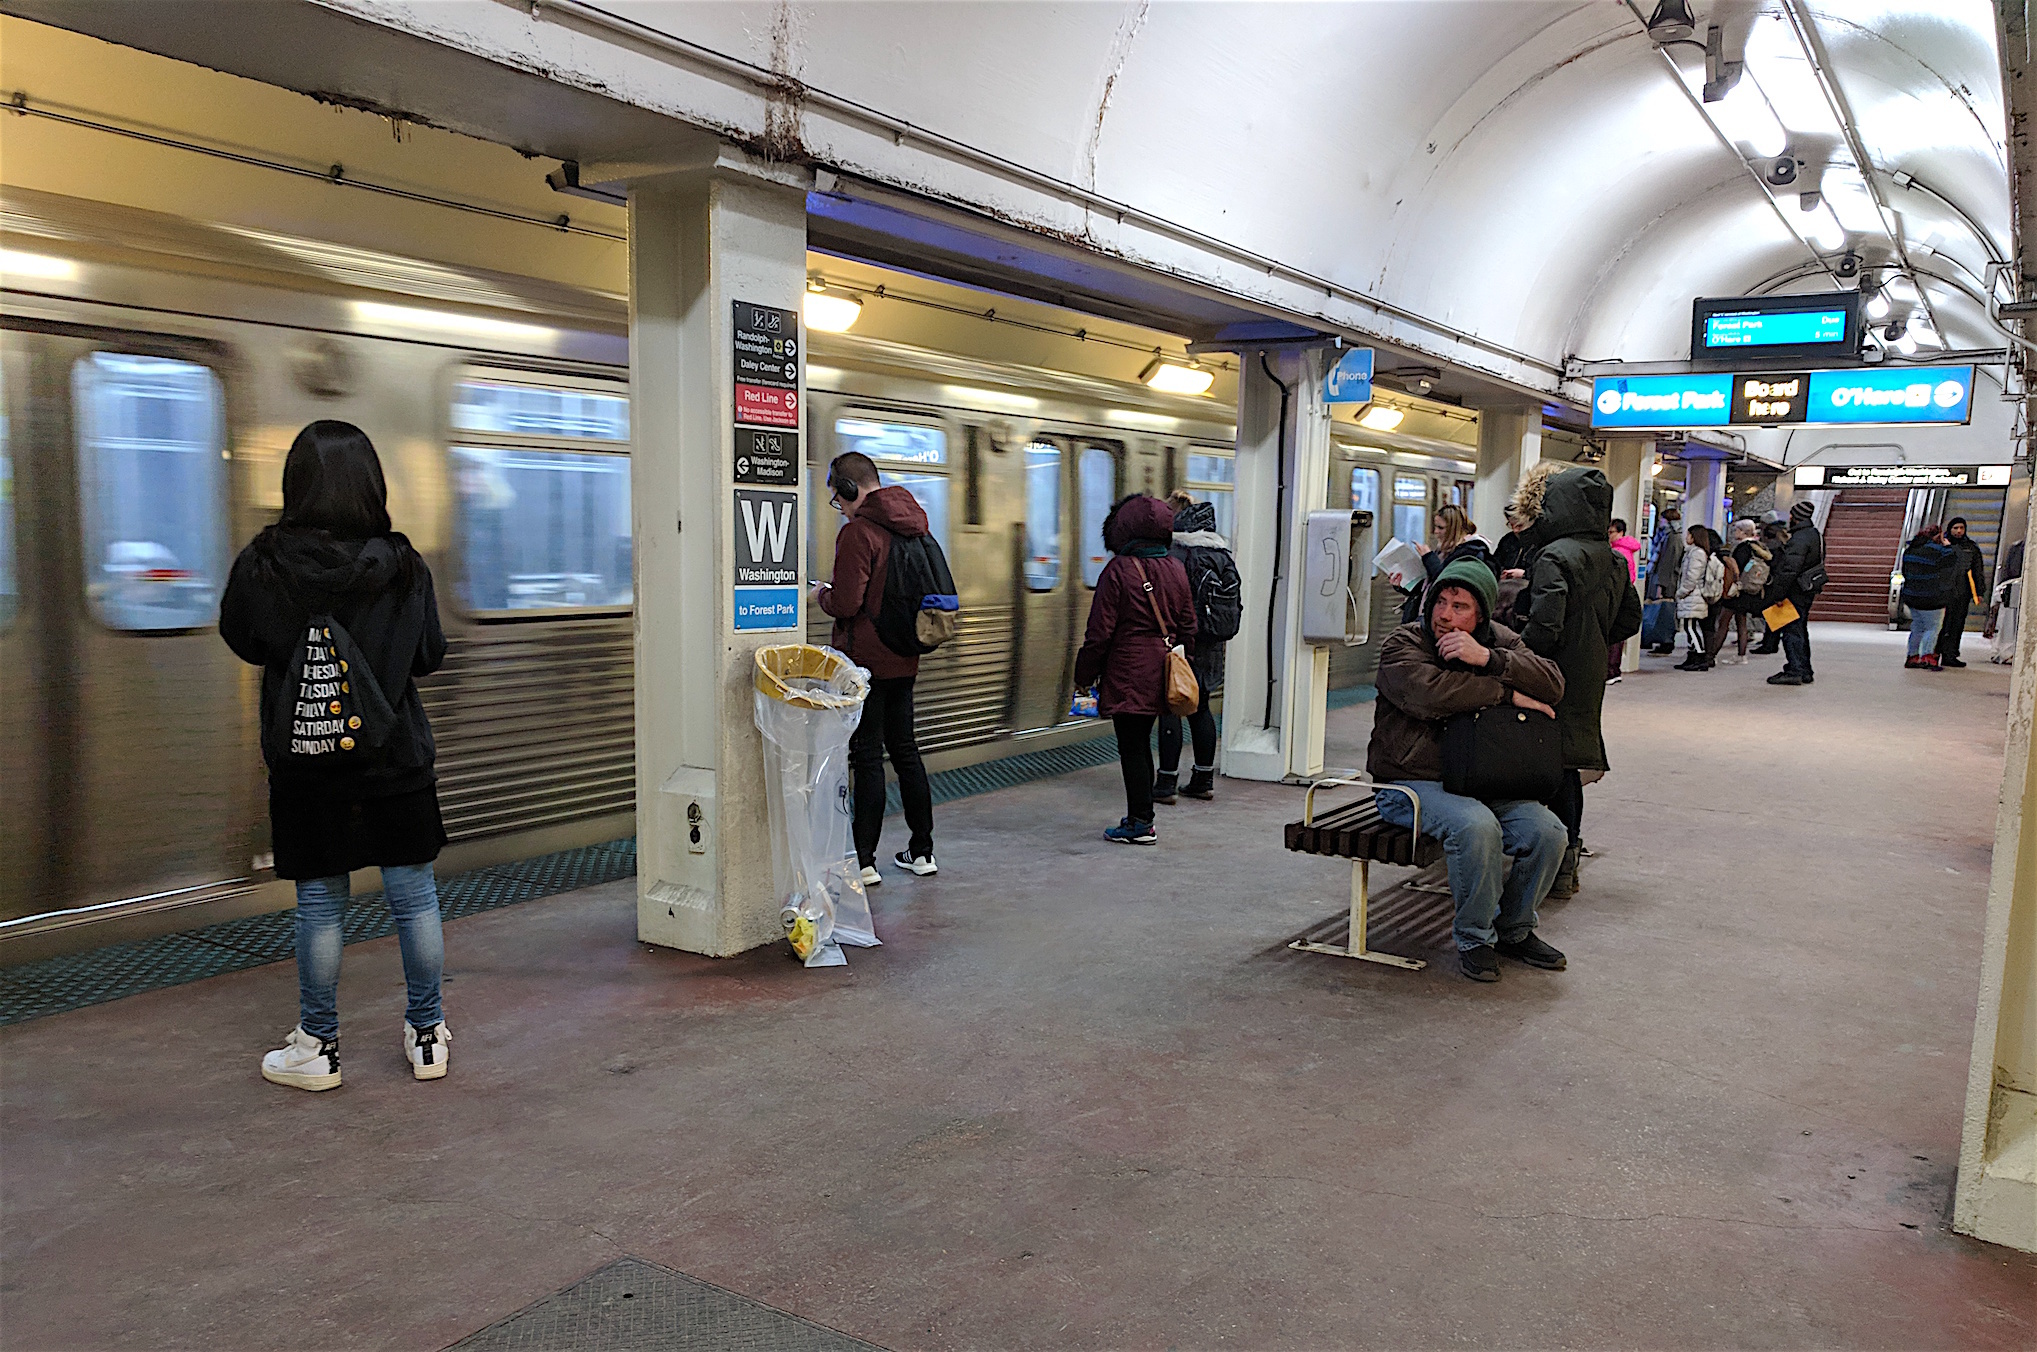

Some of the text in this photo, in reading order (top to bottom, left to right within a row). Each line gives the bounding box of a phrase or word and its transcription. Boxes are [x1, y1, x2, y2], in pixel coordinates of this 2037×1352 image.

[1821, 316, 1840, 324] Due
[737, 330, 770, 344] Randolph-
[735, 340, 773, 355] Washington
[741, 358, 781, 373] Daley Center
[1337, 371, 1368, 381] Phone
[1744, 379, 1800, 397] Board
[744, 389, 779, 404] Red Line
[1622, 389, 1726, 411] Forest Park
[1831, 387, 1906, 407] O'Hare
[1749, 399, 1791, 416] here
[750, 456, 790, 468] Washington-
[756, 466, 784, 477] Madison
[740, 500, 793, 563] W
[738, 567, 796, 584] Washington
[738, 603, 795, 616] to Forest Park
[290, 738, 336, 755] SUNDAY
